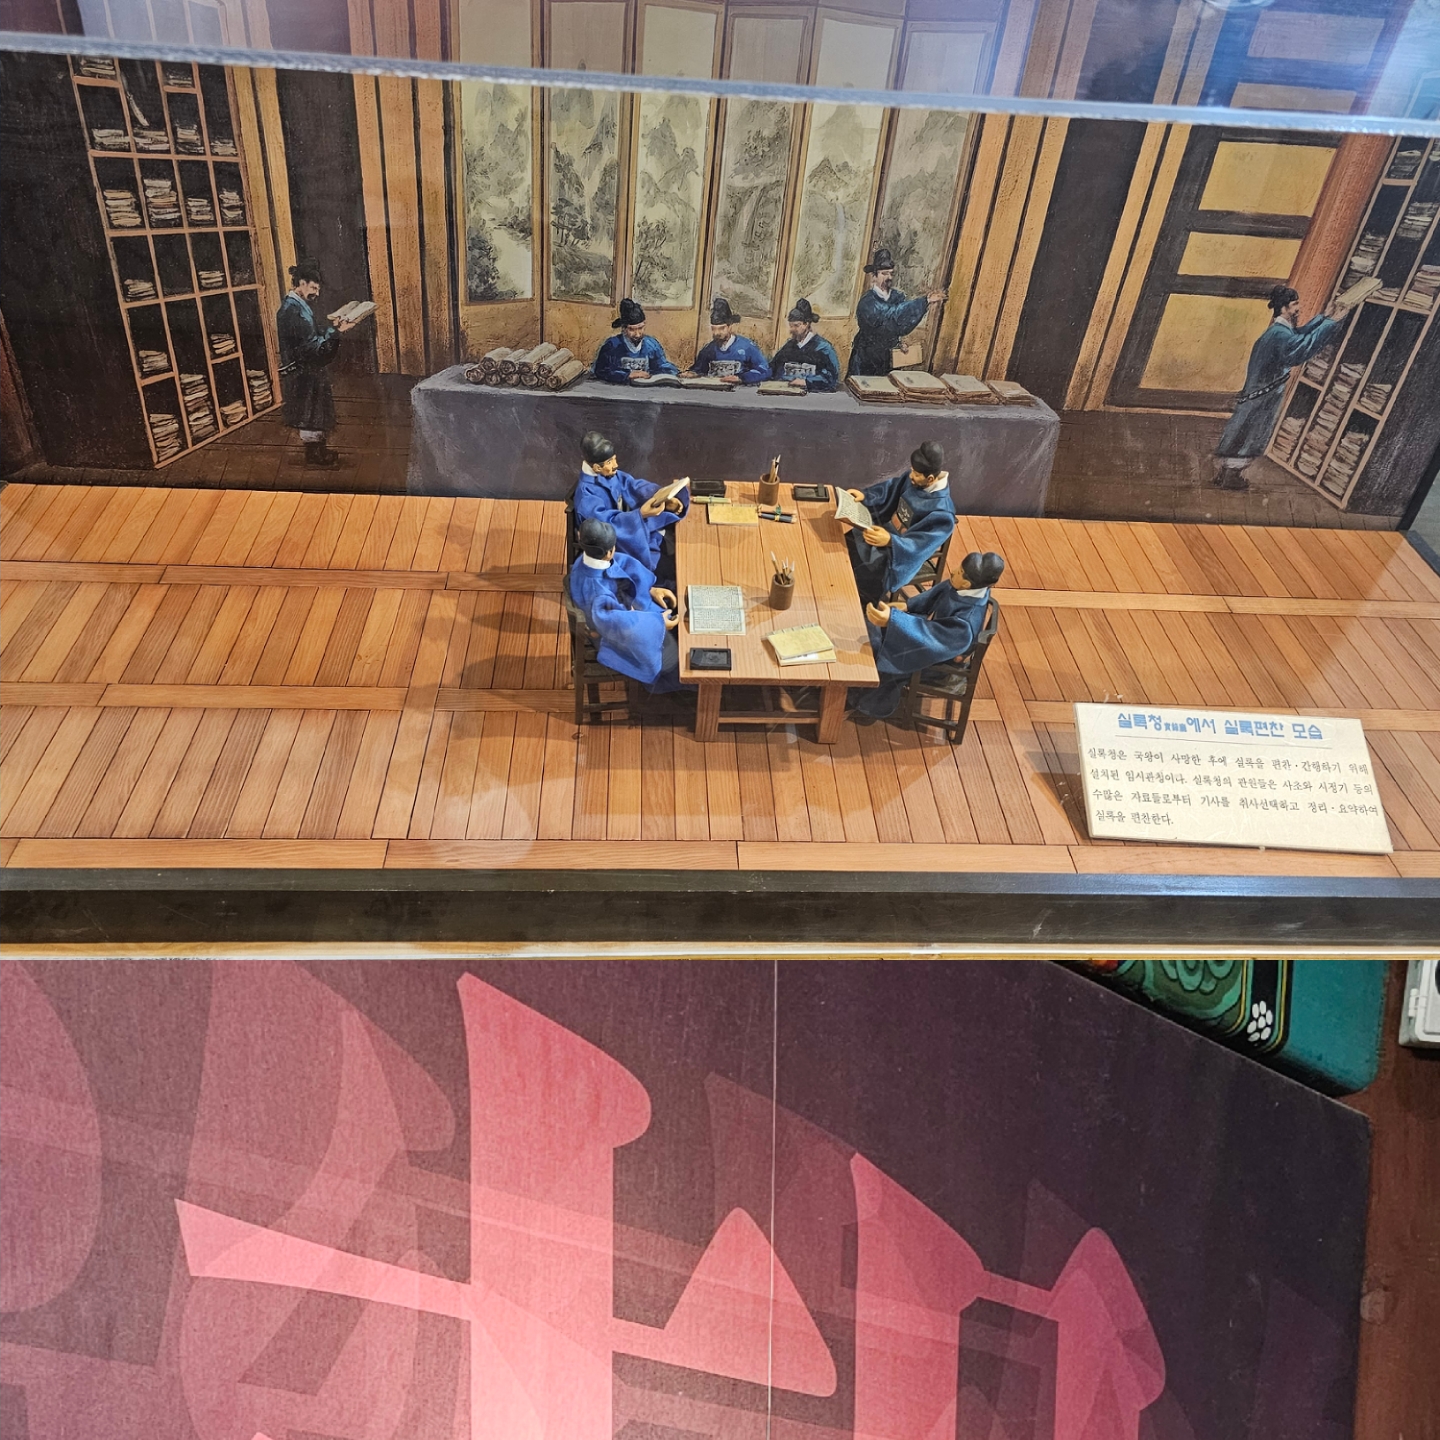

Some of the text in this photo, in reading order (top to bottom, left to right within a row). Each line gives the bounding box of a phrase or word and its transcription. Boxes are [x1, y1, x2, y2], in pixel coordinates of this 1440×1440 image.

[1224, 719, 1285, 738] 실록편찬
[1292, 723, 1323, 740] 모습
[1087, 747, 1127, 761] 실록청은
[1134, 750, 1164, 763] 국왕이
[1170, 753, 1201, 766] 사망한
[1207, 755, 1227, 767] 후에
[1235, 757, 1265, 769] 실록을
[1348, 763, 1369, 775] 위해
[1090, 768, 1119, 780] 설치된
[1193, 774, 1232, 787] 실록청의
[1237, 777, 1277, 790] 관원들은
[1282, 780, 1313, 792] 사초와
[1318, 782, 1348, 794] 시정기
[1353, 784, 1373, 795] 등의
[1092, 789, 1123, 801] 수많은
[1131, 791, 1191, 806] 자료들로부터
[1200, 795, 1230, 808] 기사를
[1095, 809, 1174, 825] 실록을 편찬한다.
